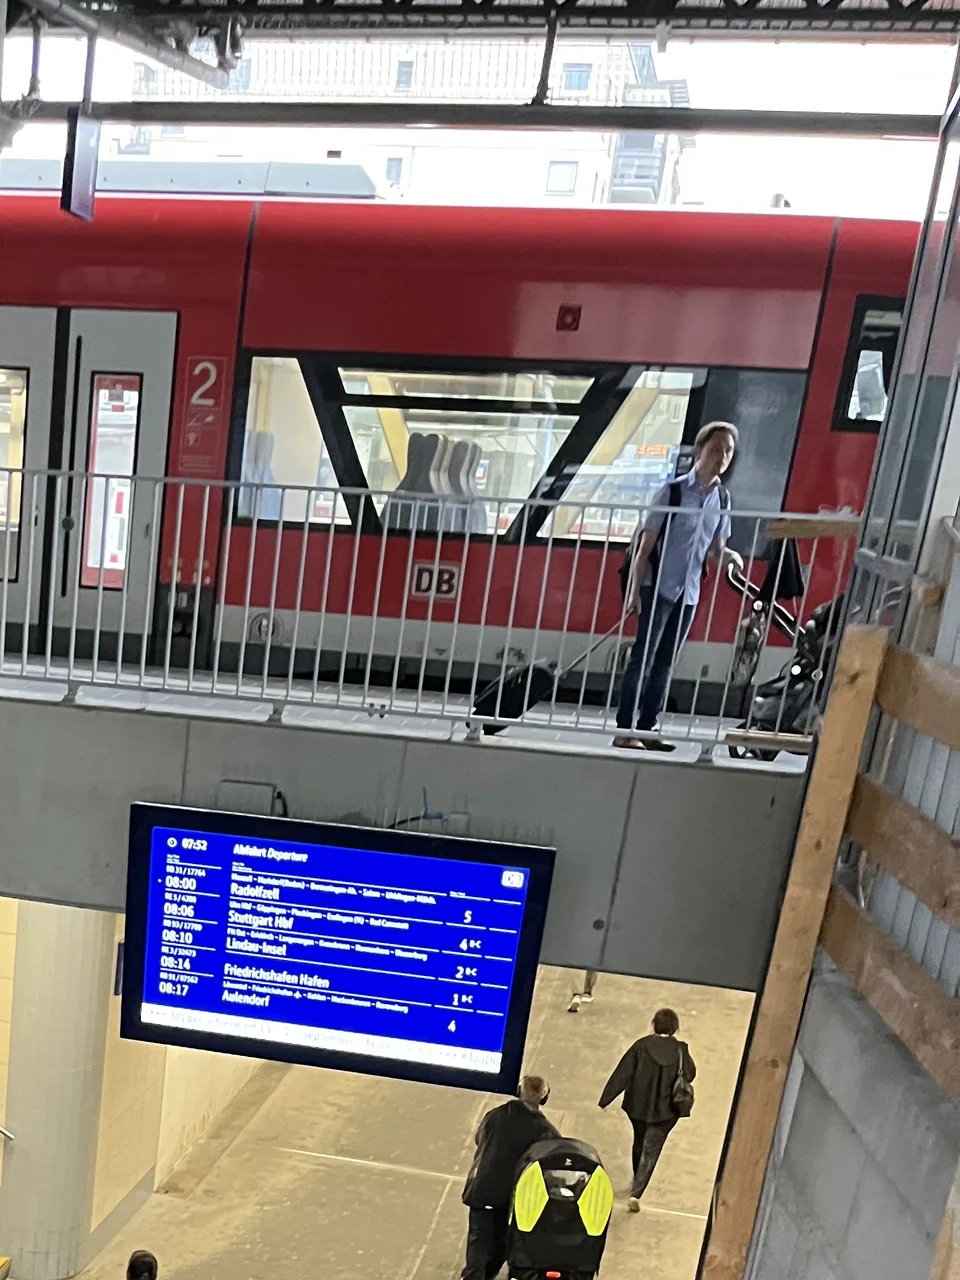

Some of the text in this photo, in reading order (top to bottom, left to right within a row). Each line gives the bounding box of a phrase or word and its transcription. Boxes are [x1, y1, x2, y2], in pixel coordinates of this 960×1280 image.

[190, 361, 217, 406] 2
[415, 567, 456, 594] DB
[182, 838, 208, 851] 07:52
[233, 843, 309, 862] Abfahrt Departure
[165, 875, 197, 890] 08:00
[230, 882, 280, 900] Radolfzell
[163, 902, 195, 917] 08:06
[463, 910, 472, 923] 5
[228, 909, 294, 929] Stuttgart Hbf
[162, 929, 193, 944] 08:10
[226, 936, 287, 956] Lindau-Insel
[459, 938, 468, 951] 4
[160, 955, 191, 970] 08:14
[224, 963, 330, 989] Friedrichshafen Hafen
[455, 966, 464, 979] 2
[159, 981, 189, 996] 08:17
[222, 989, 270, 1007] Aulendorf
[452, 993, 459, 1006] 1
[447, 1020, 456, 1032] 4
